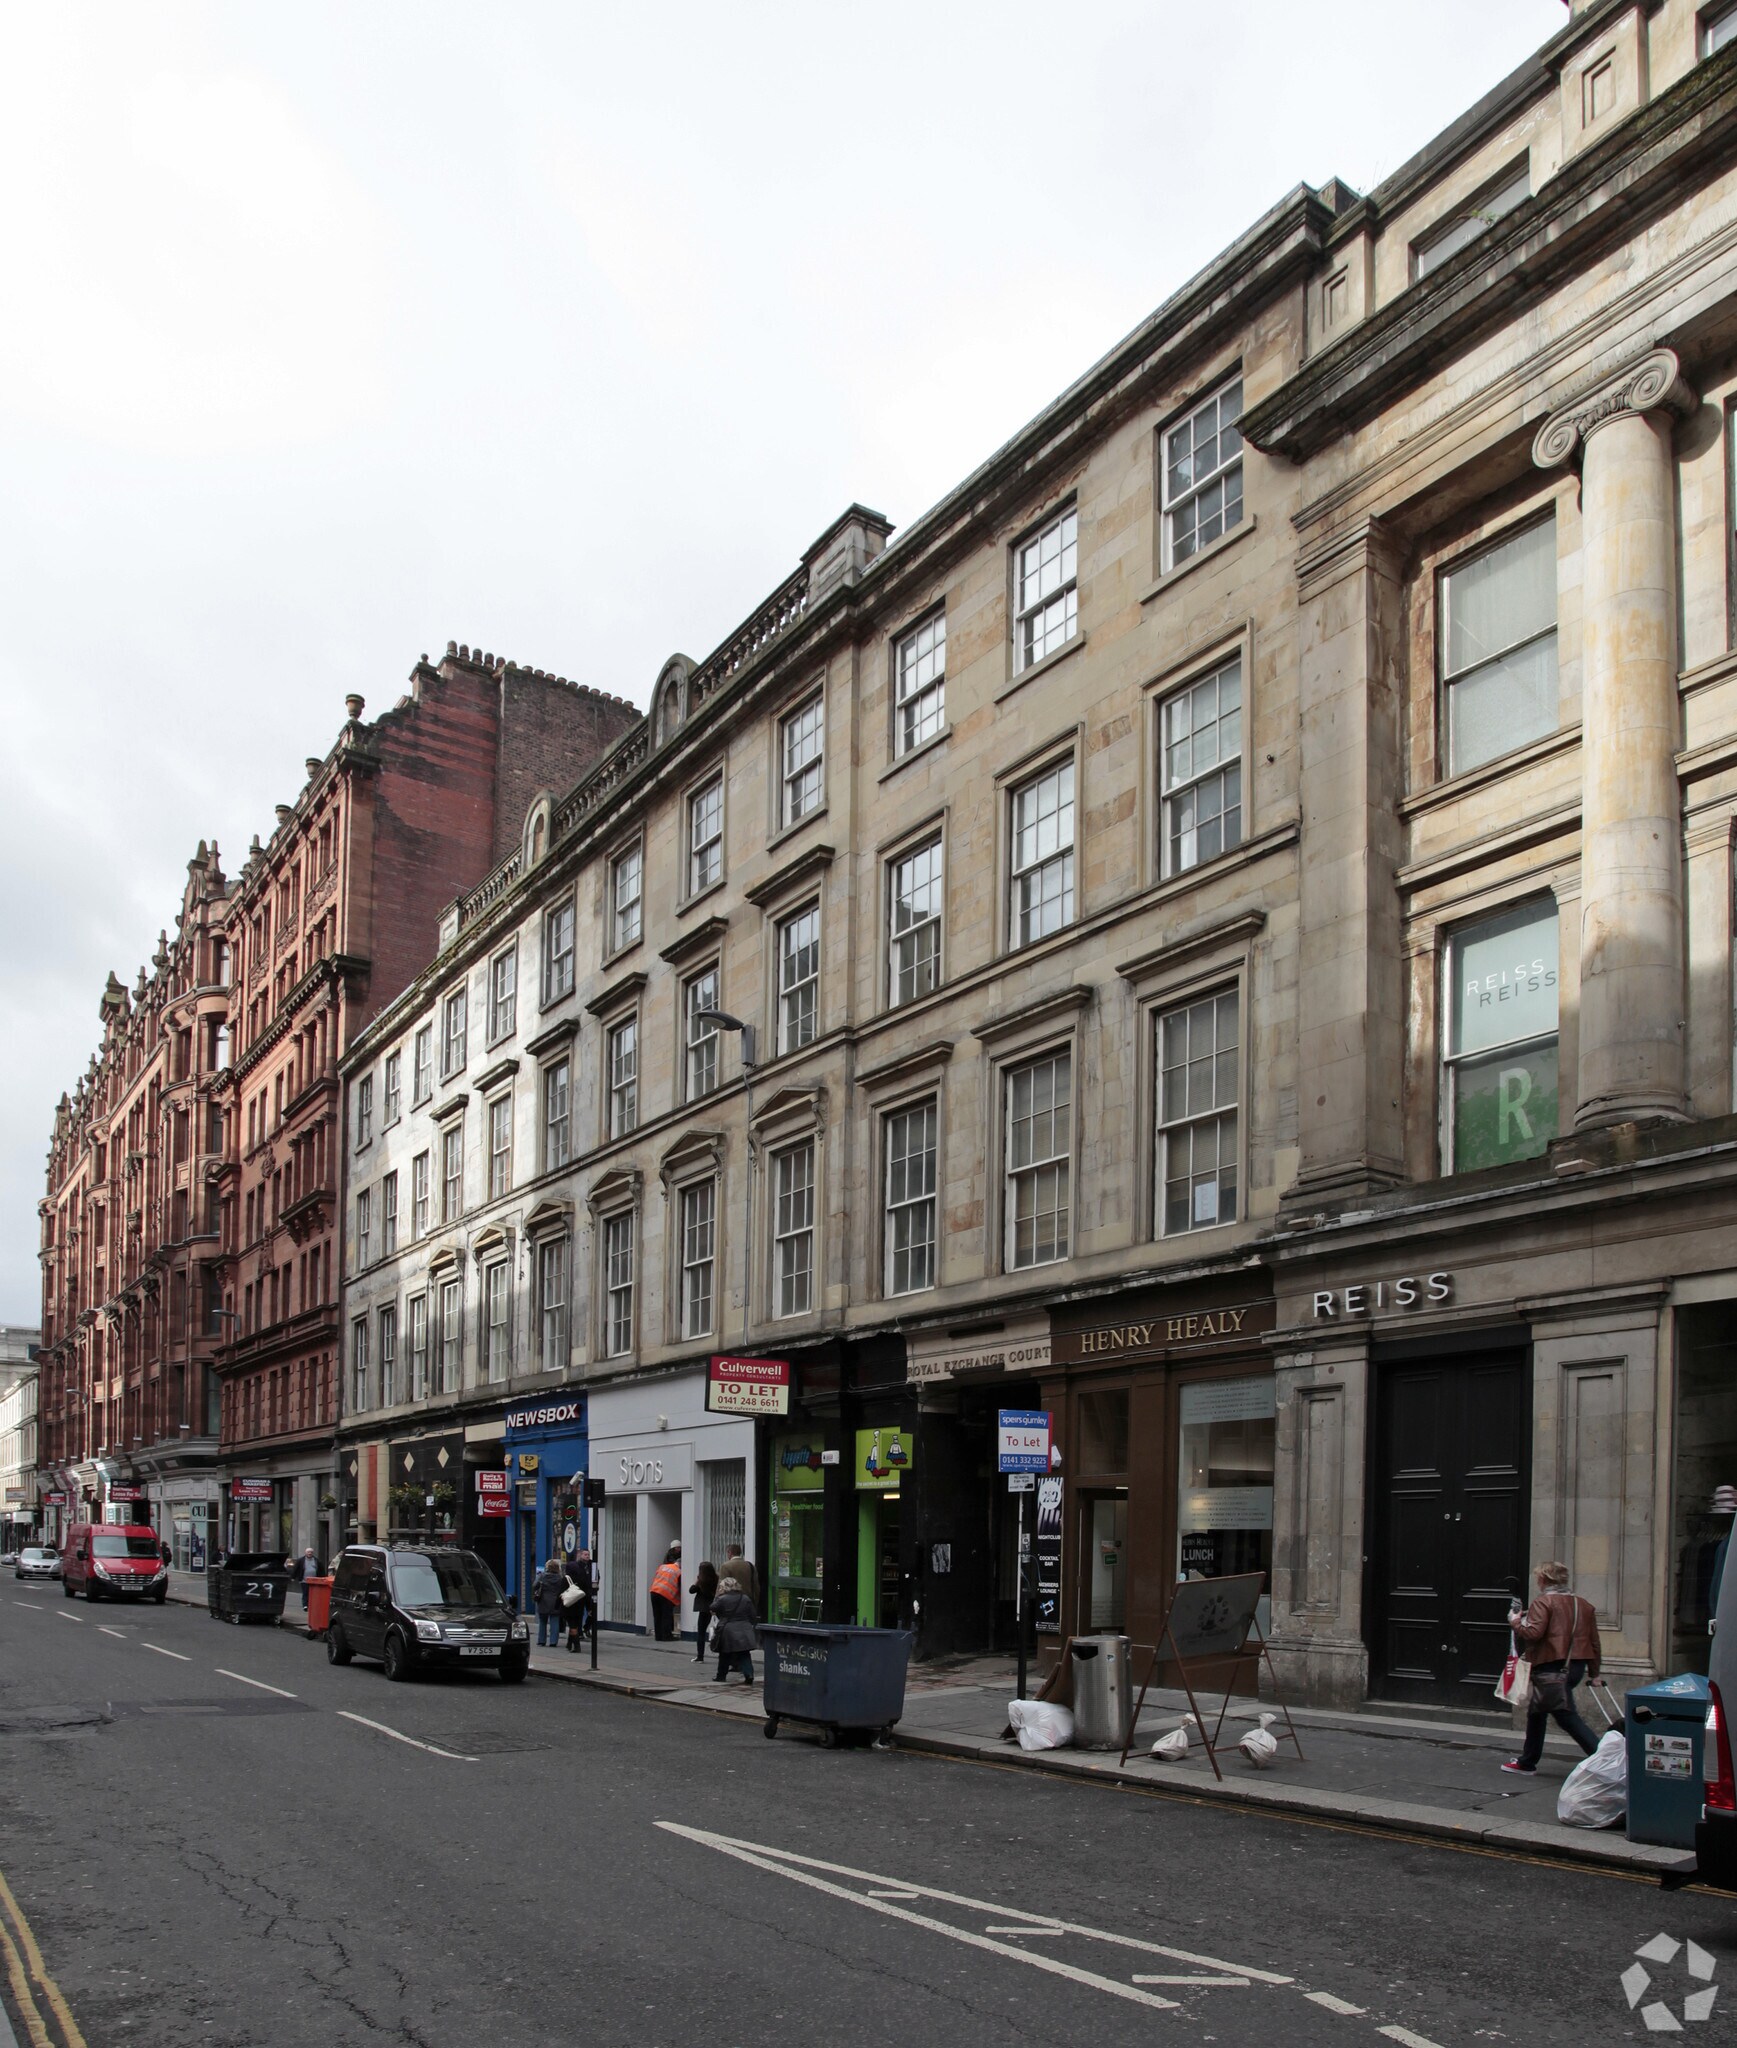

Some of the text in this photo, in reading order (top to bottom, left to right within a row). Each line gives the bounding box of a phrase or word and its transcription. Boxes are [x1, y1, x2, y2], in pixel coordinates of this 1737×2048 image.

[1467, 958, 1544, 997] REISS
[1499, 1067, 1534, 1145] R
[1313, 1272, 1449, 1318] REISS
[1081, 1309, 1247, 1353] HENRY HEALY
[719, 1361, 782, 1375] Culverwell
[907, 1346, 1050, 1377] ROYAL EXCHANGE COURT
[718, 1383, 779, 1397] TO LET
[718, 1396, 737, 1404] 0141
[760, 1399, 779, 1407] 6611
[506, 1403, 578, 1428] NEWSBOX
[1006, 1436, 1040, 1447] To Let
[1002, 1456, 1018, 1464] 0141
[620, 1455, 663, 1486] Stons
[1182, 1549, 1214, 1561] LUNCH
[245, 1582, 274, 1597] 29
[779, 1660, 811, 1676] shanks.
